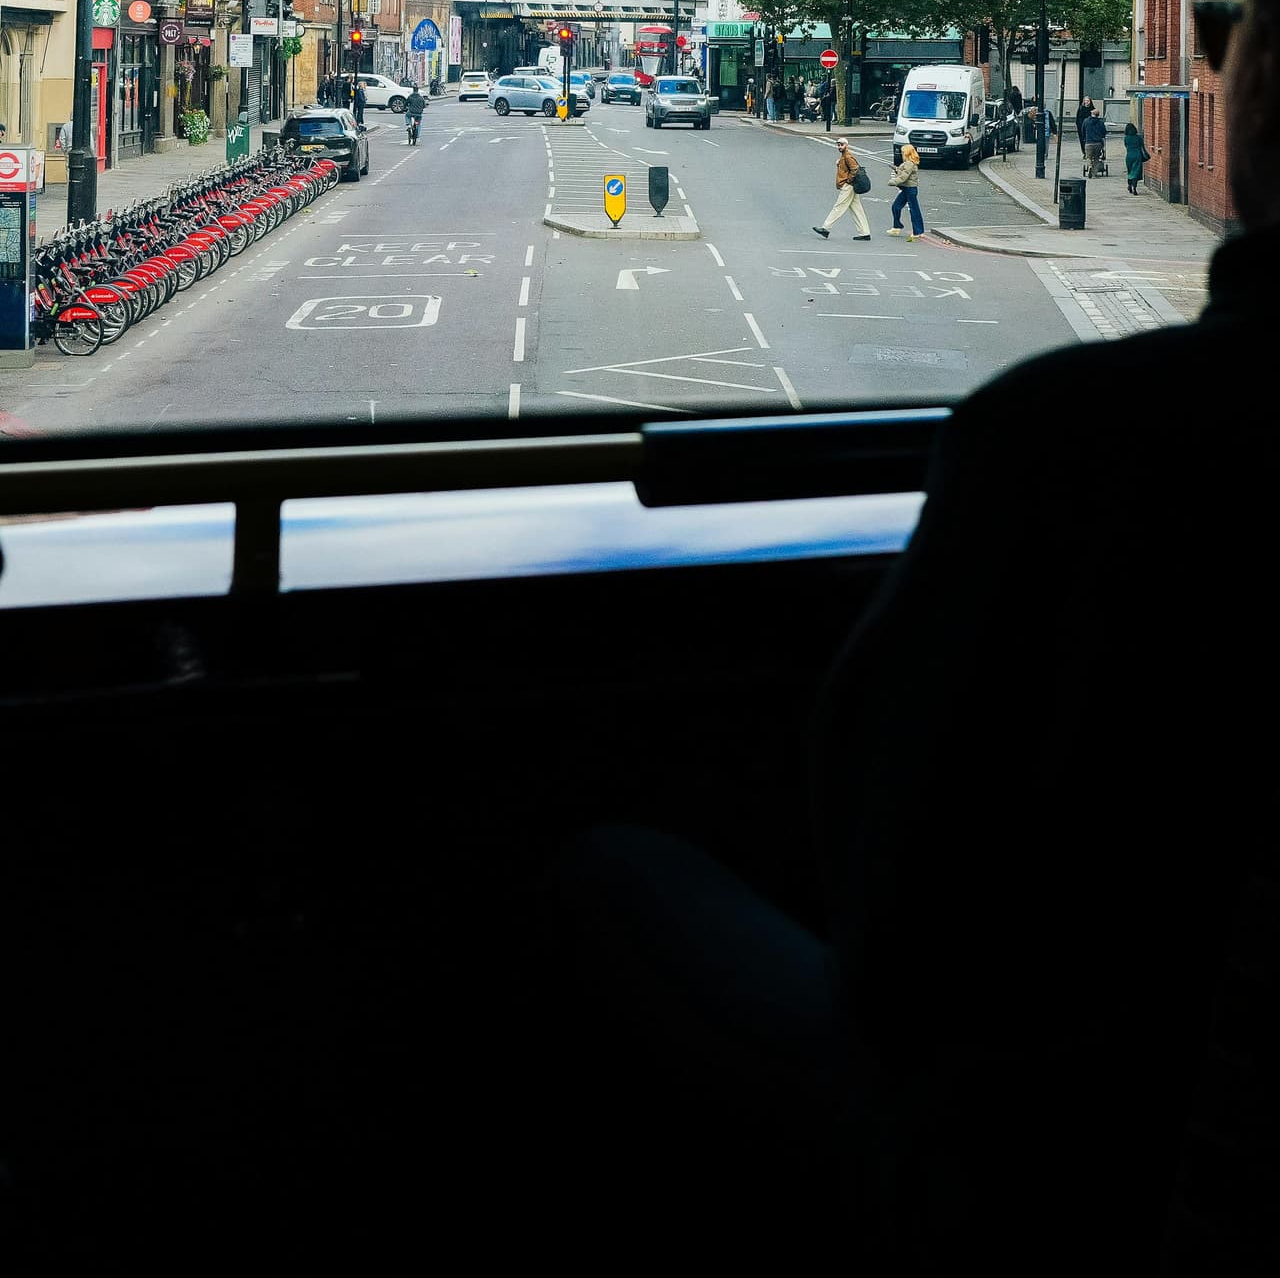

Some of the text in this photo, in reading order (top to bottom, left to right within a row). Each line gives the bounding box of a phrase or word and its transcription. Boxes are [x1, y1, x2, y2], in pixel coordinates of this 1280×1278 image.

[336, 242, 481, 253] KEEP
[304, 254, 496, 267] CLEAR
[768, 266, 974, 282] CLEAR
[800, 282, 972, 300] KEEP
[315, 303, 414, 320] 20
